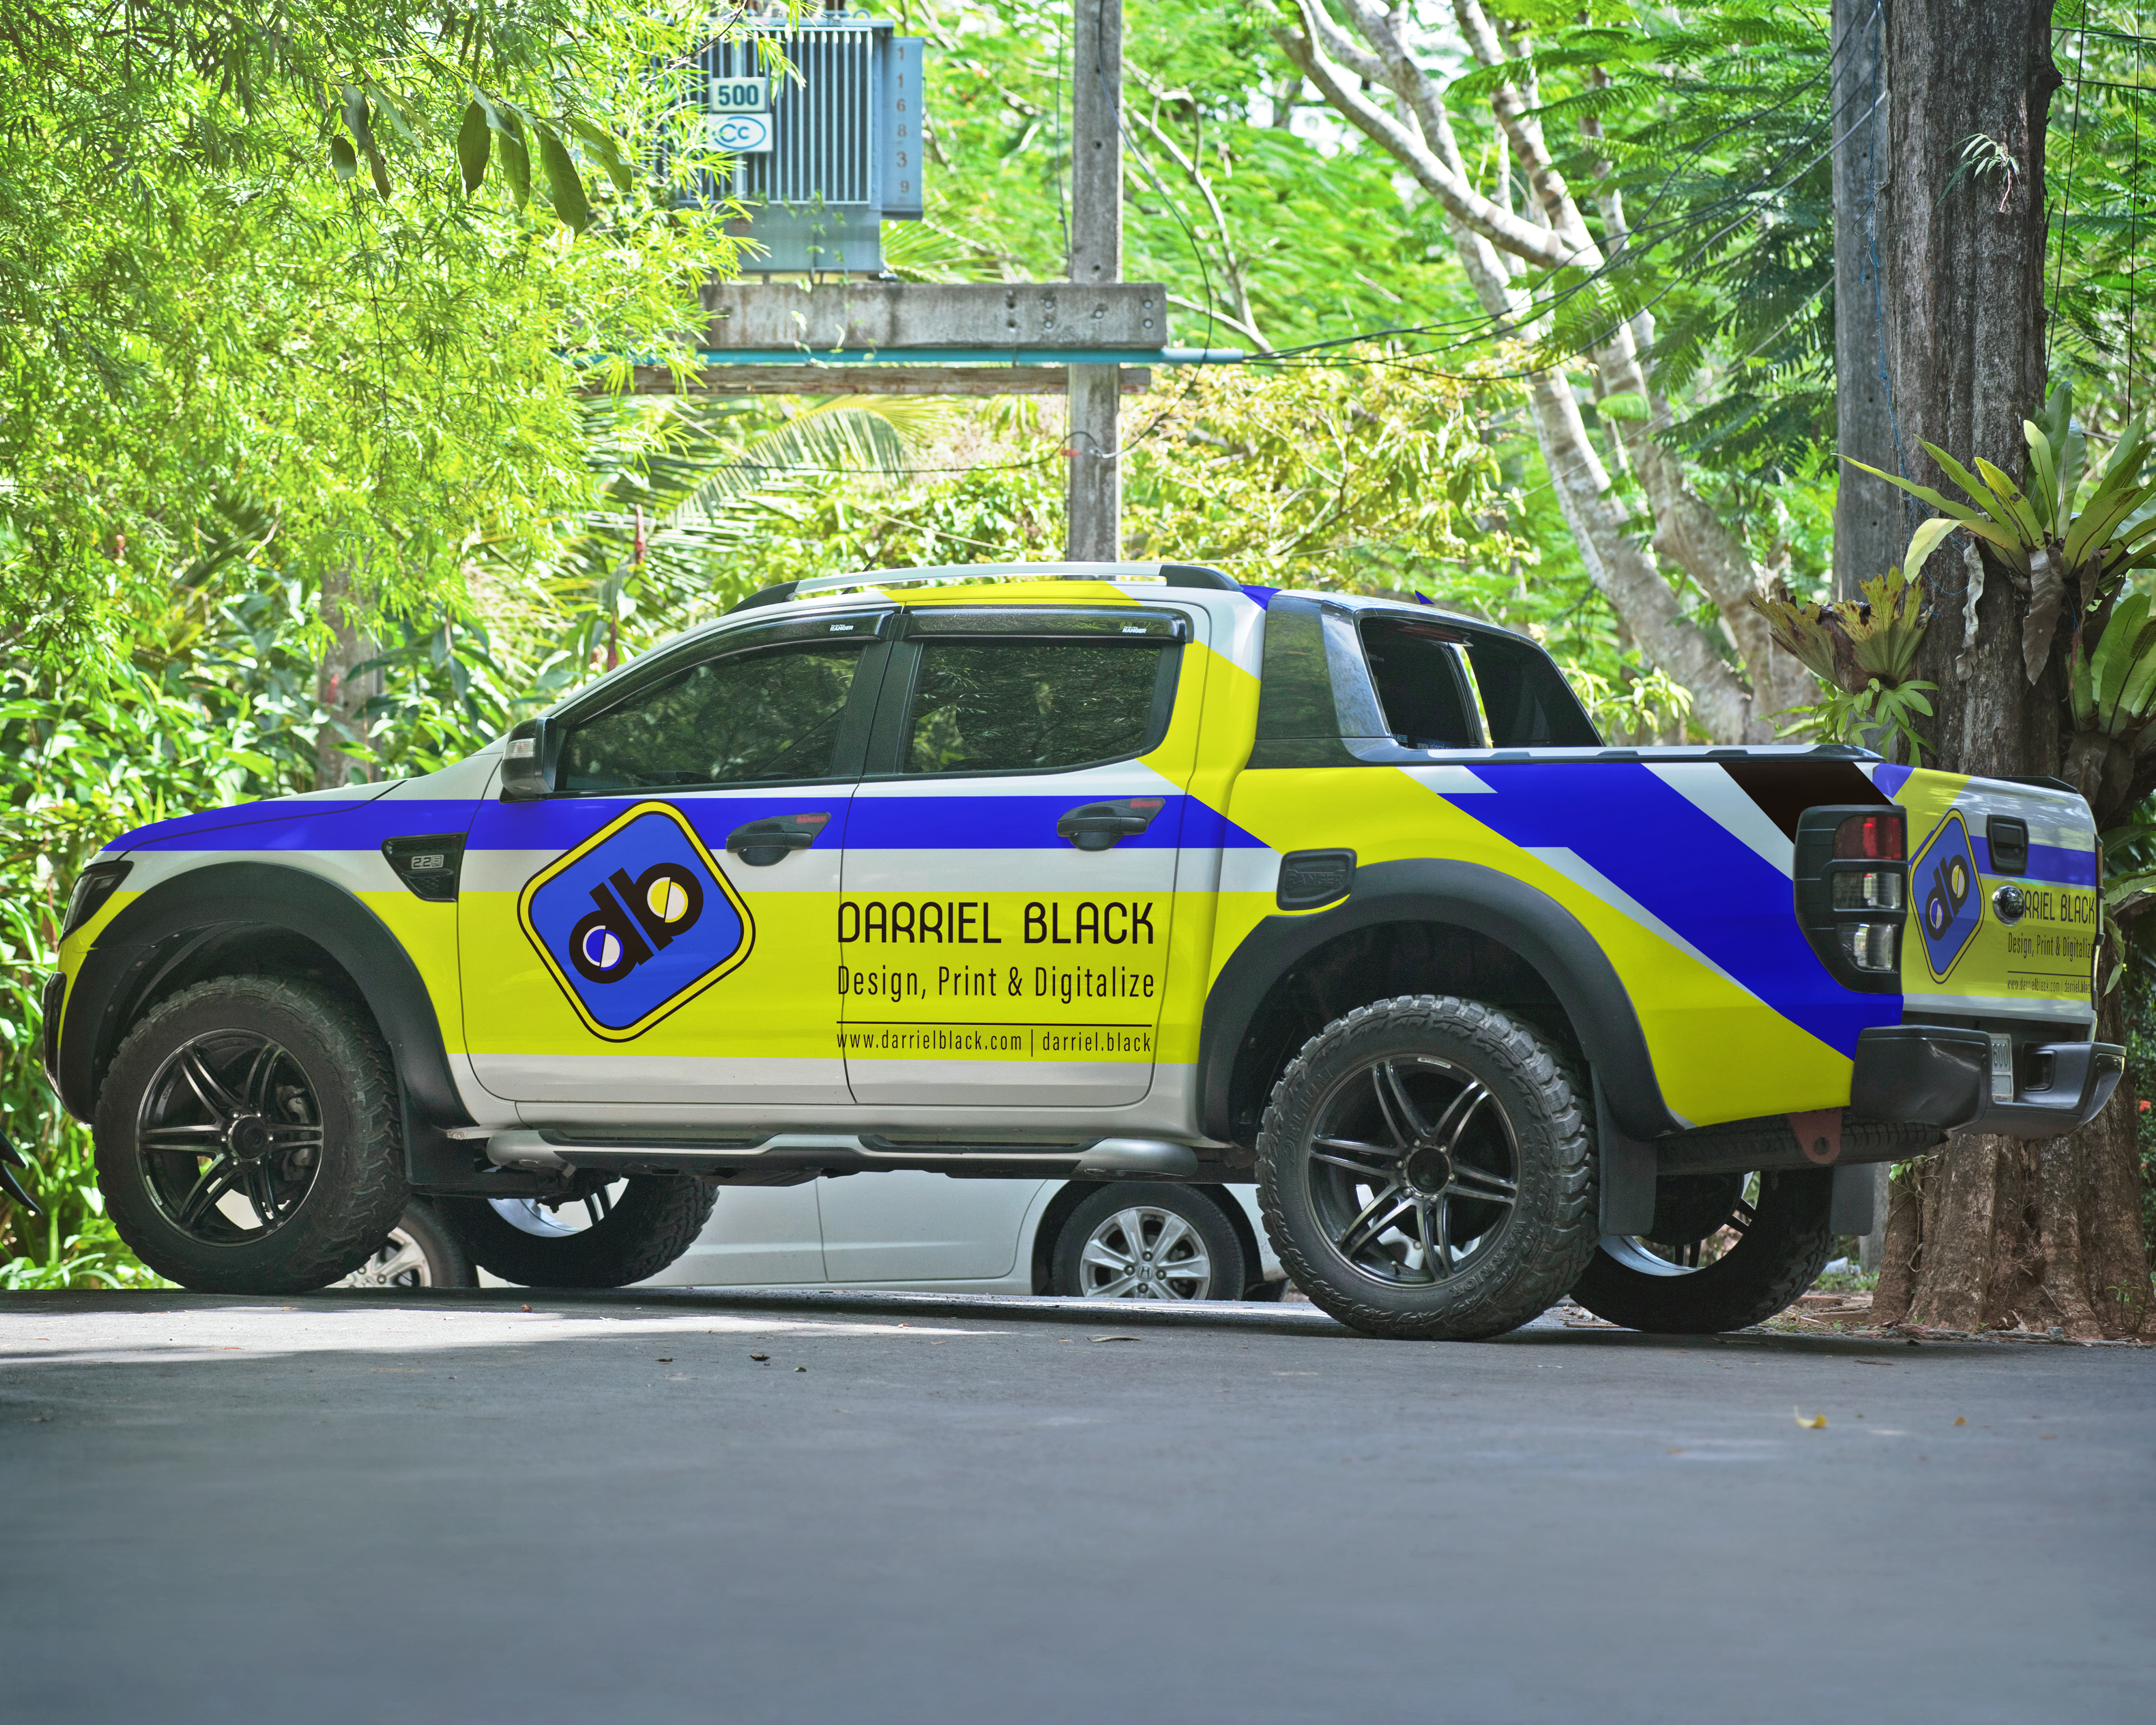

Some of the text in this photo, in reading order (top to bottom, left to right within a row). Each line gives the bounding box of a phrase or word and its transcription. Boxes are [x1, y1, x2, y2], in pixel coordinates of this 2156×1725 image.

[718, 84, 759, 106] 500
[838, 901, 1153, 944] DARRIEL BLACK
[2020, 889, 2095, 924] RRIEL BLACK
[2008, 933, 2034, 958] Design,
[2037, 935, 2054, 956] Print
[2056, 936, 2061, 956] &
[838, 964, 1153, 1004] Design, Print & Digitalize
[837, 1030, 1021, 1050] www.darrielblack.com
[1042, 1031, 1151, 1052] darriel.black
[1449, 1221, 1527, 1297] WARRIOR
